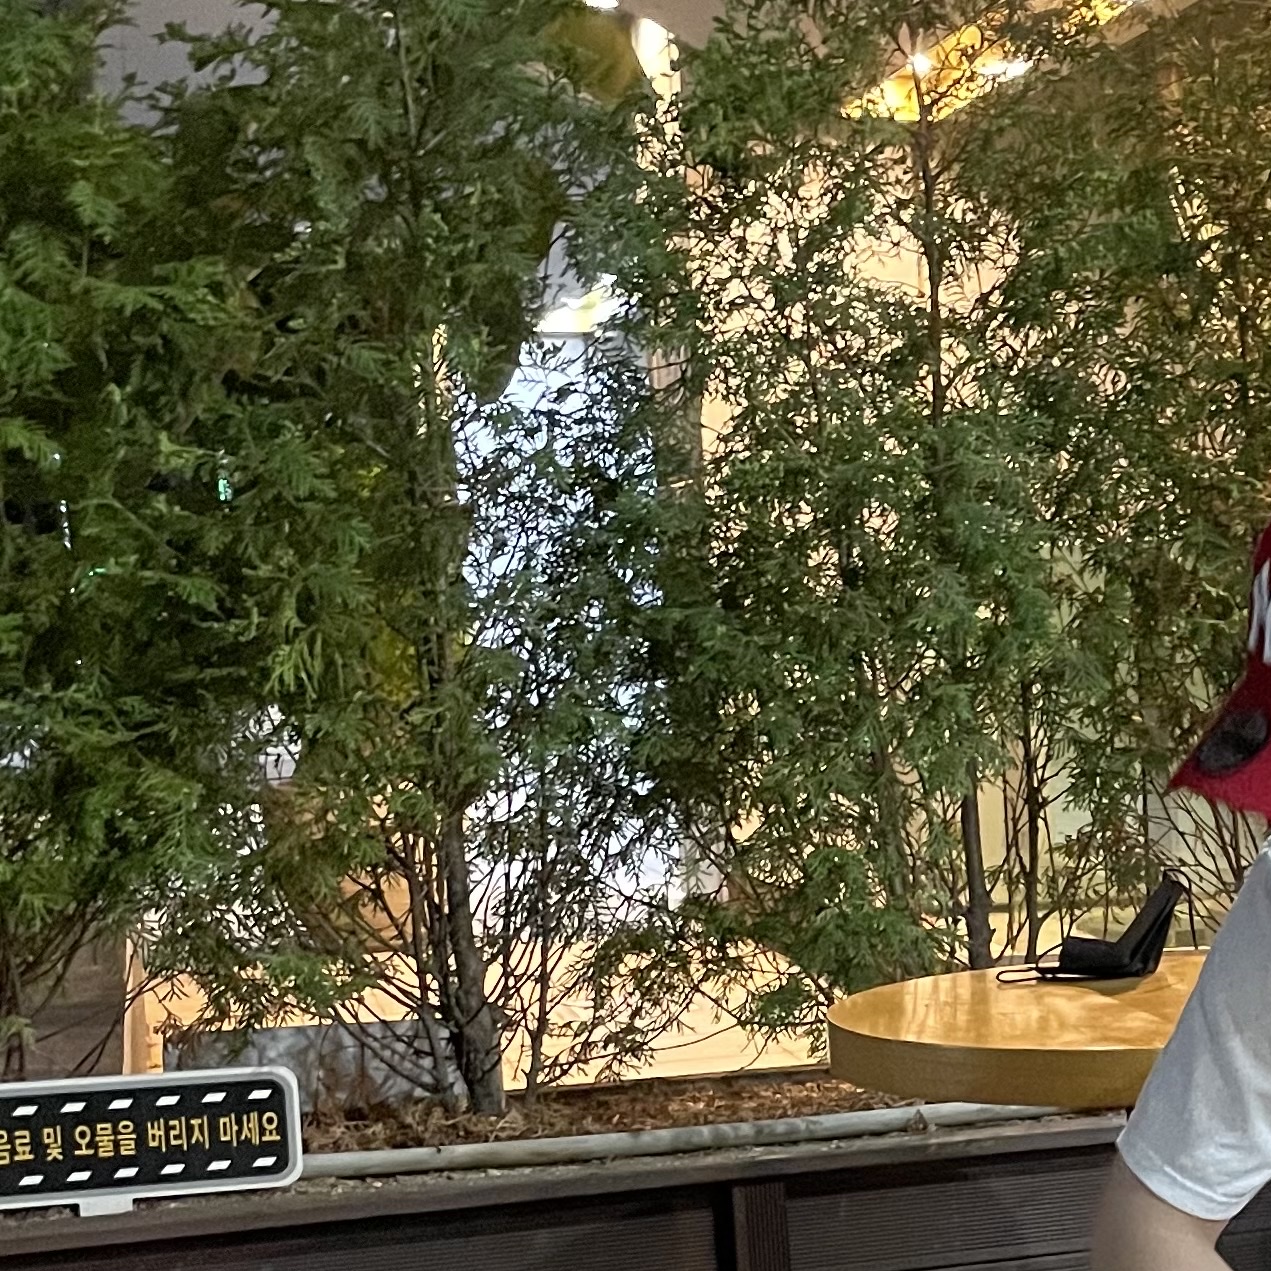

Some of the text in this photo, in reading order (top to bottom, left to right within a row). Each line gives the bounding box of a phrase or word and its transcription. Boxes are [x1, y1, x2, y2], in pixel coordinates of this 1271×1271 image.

[43, 1125, 64, 1161] 및
[73, 1120, 137, 1158] 오물을
[147, 1115, 210, 1152] 버리지
[219, 1111, 281, 1147] 마세요
